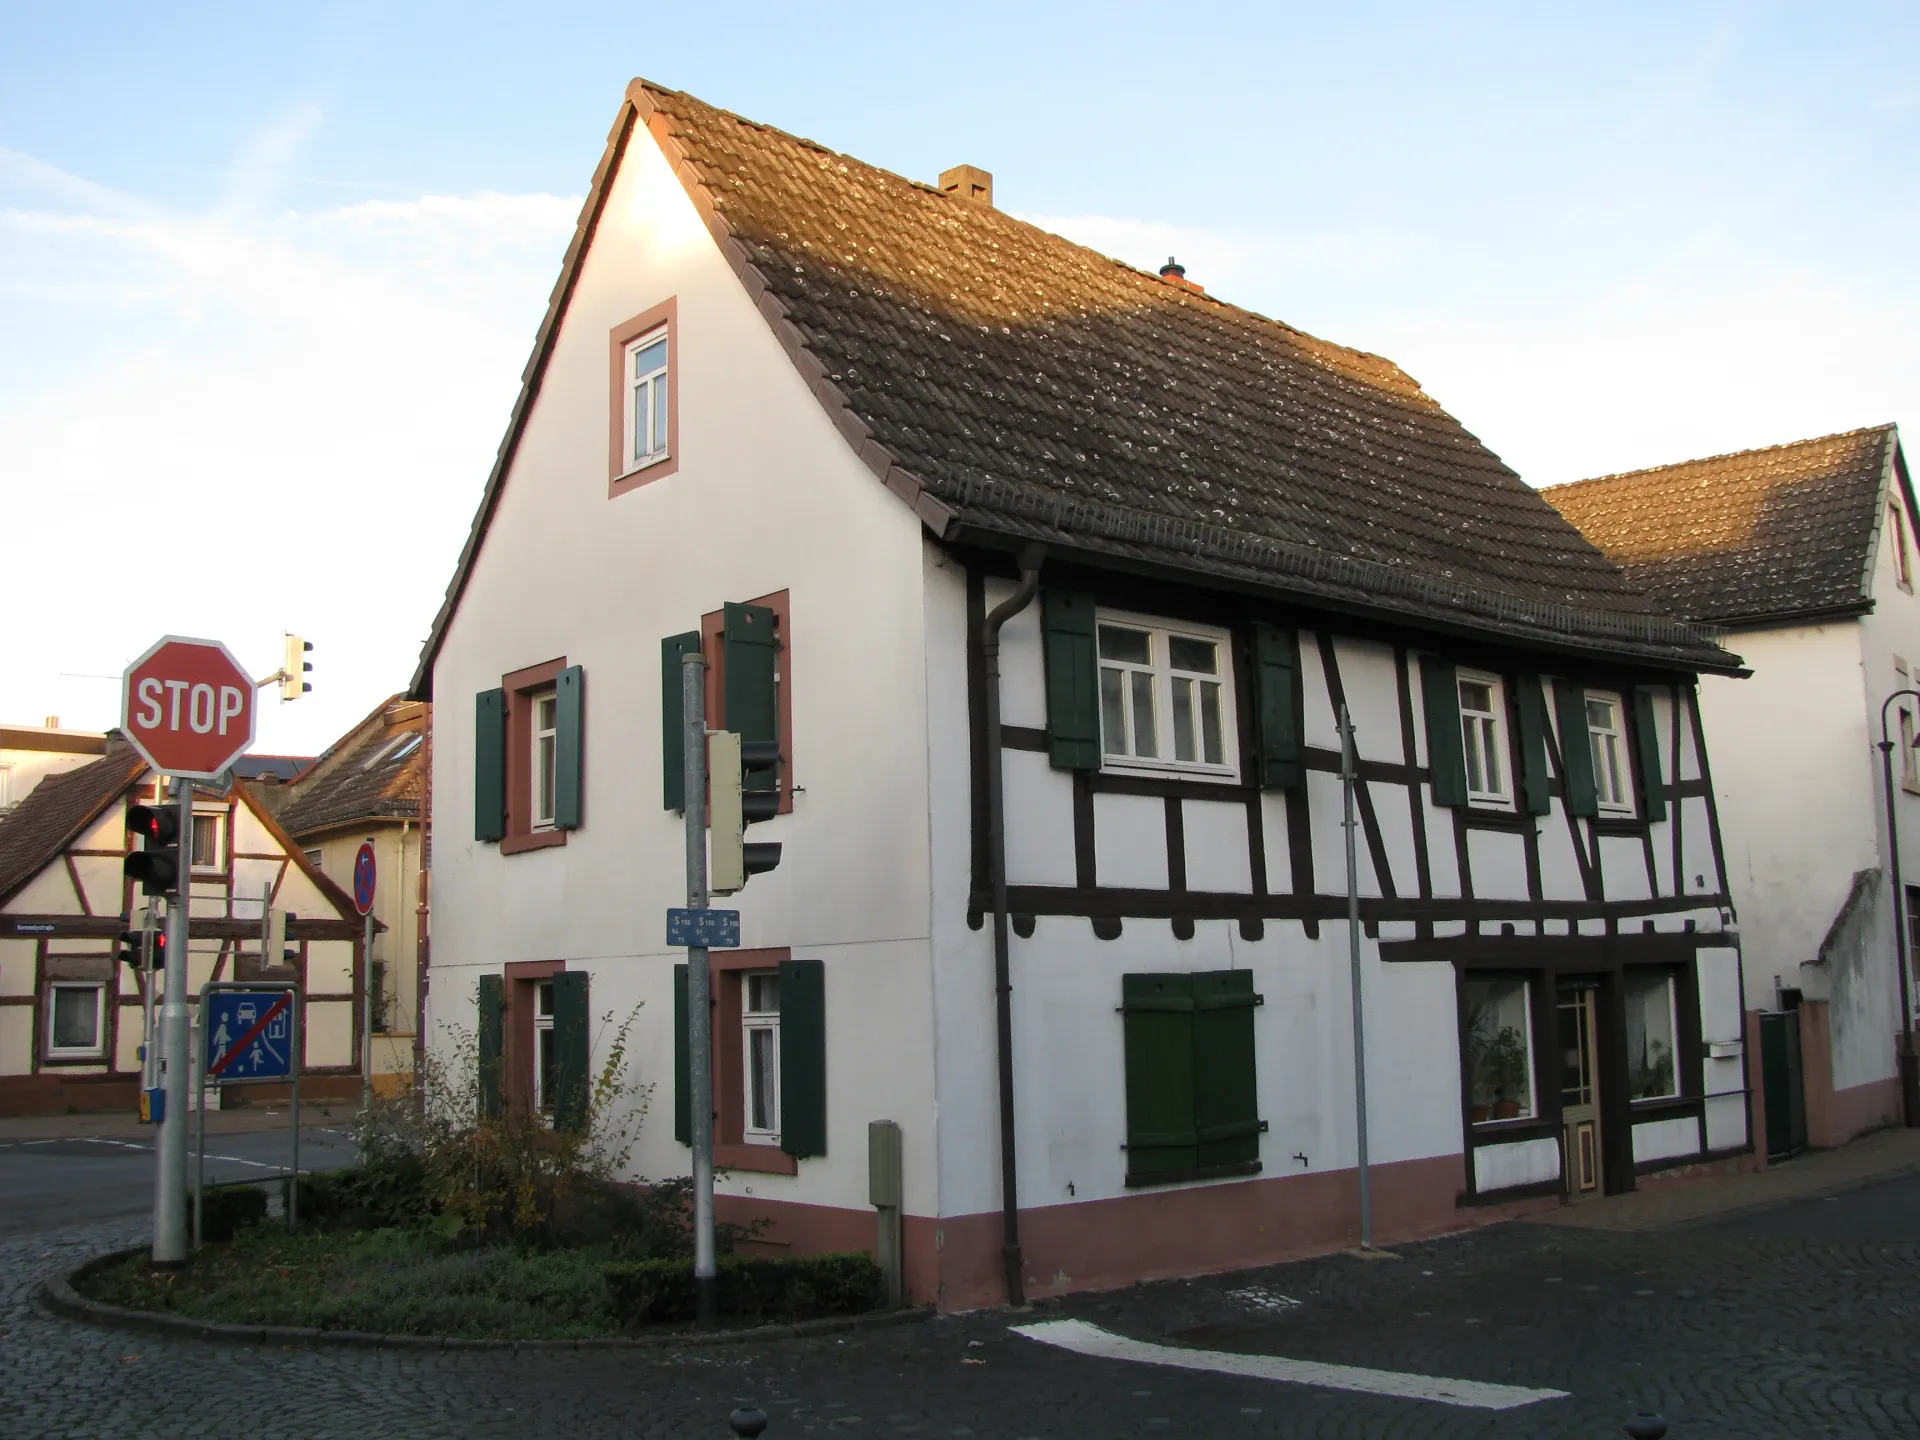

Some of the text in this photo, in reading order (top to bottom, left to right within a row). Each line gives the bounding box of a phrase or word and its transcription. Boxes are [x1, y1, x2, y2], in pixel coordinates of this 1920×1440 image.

[136, 677, 243, 736] STOP
[674, 916, 680, 925] S
[698, 916, 704, 926] S
[722, 917, 728, 927] S
